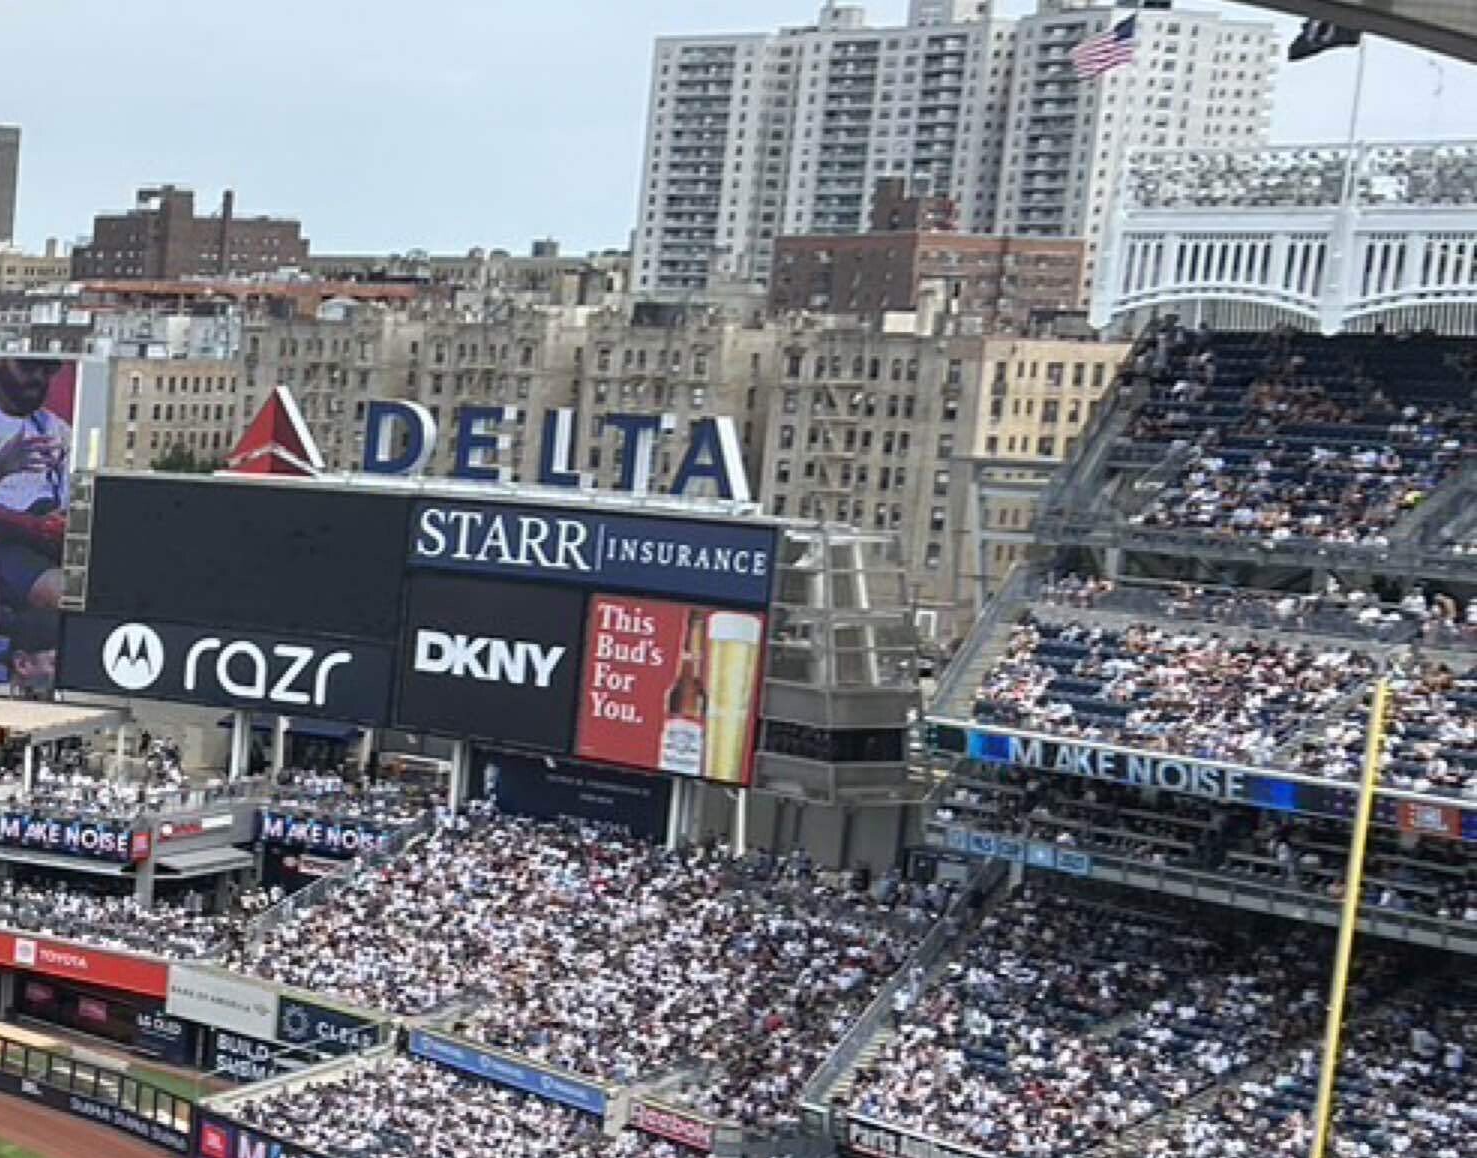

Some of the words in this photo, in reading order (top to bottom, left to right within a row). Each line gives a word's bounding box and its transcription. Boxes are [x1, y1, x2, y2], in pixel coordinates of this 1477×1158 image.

[362, 400, 752, 501] DELTA
[415, 508, 591, 572] STARR
[605, 538, 768, 577] INSURANCE
[597, 603, 656, 635] This
[414, 629, 566, 689] DKNY
[596, 631, 665, 667] Bud's
[184, 636, 352, 706] razr
[592, 660, 637, 693] For
[590, 691, 645, 725] You.
[1010, 736, 1117, 781] MAKE
[1128, 756, 1247, 799] NOISE
[0, 814, 62, 844] MAKE
[66, 821, 129, 854] NOISE
[263, 813, 323, 843] MAKE
[40, 950, 88, 969] TOYOTA
